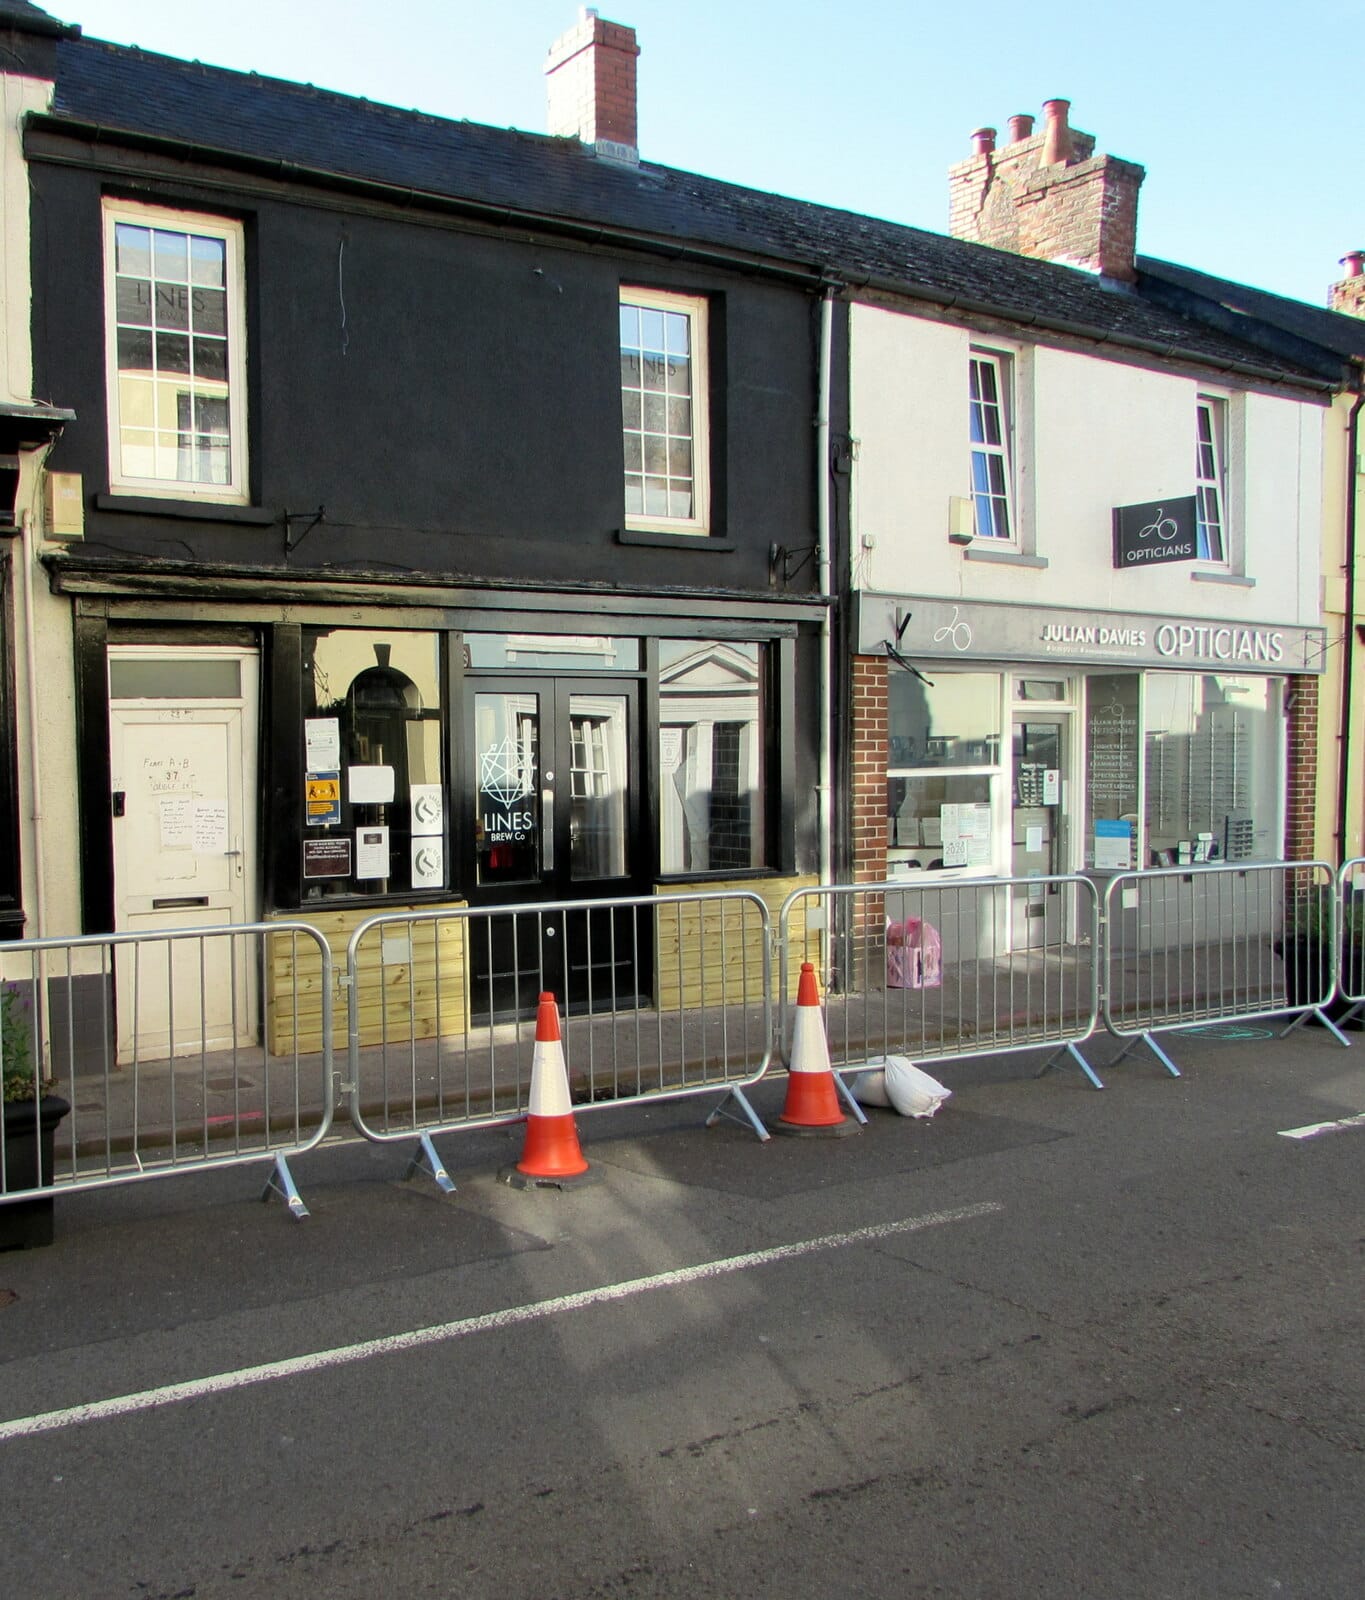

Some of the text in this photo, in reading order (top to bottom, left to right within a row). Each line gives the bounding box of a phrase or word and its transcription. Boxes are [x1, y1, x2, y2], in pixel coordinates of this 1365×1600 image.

[136, 282, 206, 313] LINES
[1126, 543, 1192, 561] OPTICIANS
[1043, 624, 1095, 643] JULIAN
[1100, 628, 1146, 647] DAVIES
[1156, 624, 1284, 662] OPTICIANS
[484, 811, 533, 832] LINES
[490, 831, 526, 842] BREW Co
